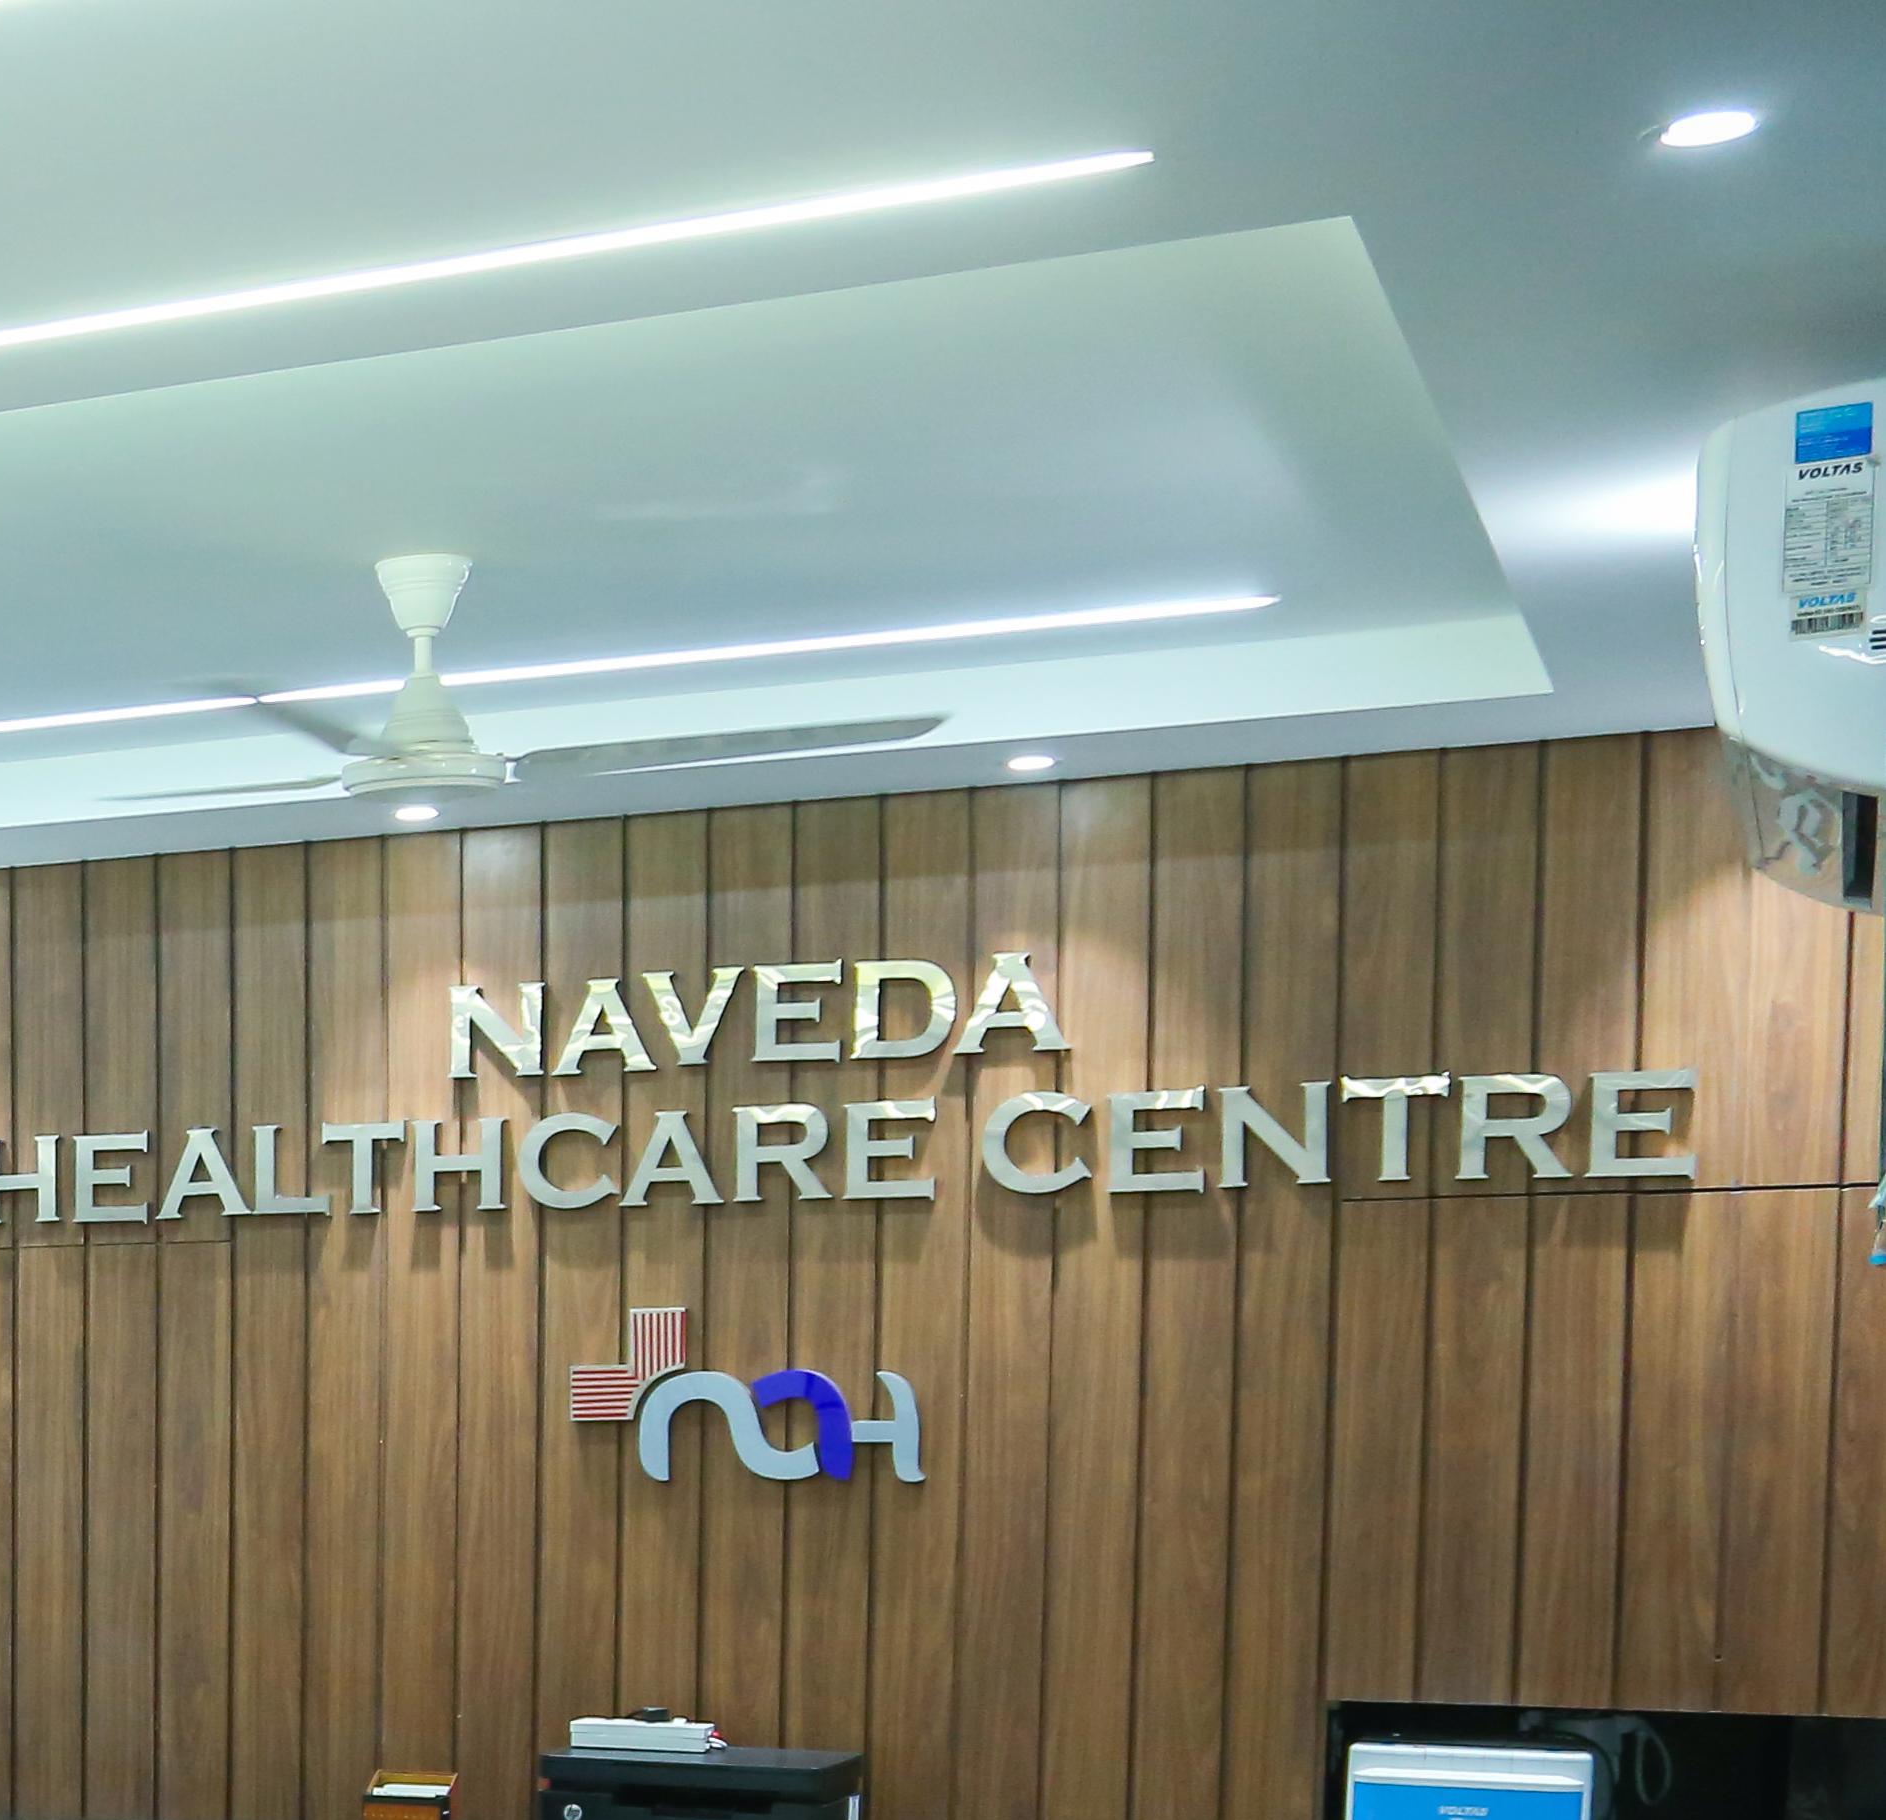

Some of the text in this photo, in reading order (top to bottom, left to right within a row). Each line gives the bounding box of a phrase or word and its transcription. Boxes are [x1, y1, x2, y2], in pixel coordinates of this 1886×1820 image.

[1798, 462, 1863, 481] VOLTAS
[448, 952, 1072, 1080] NAVEDA
[979, 1067, 1698, 1198] CENTRE
